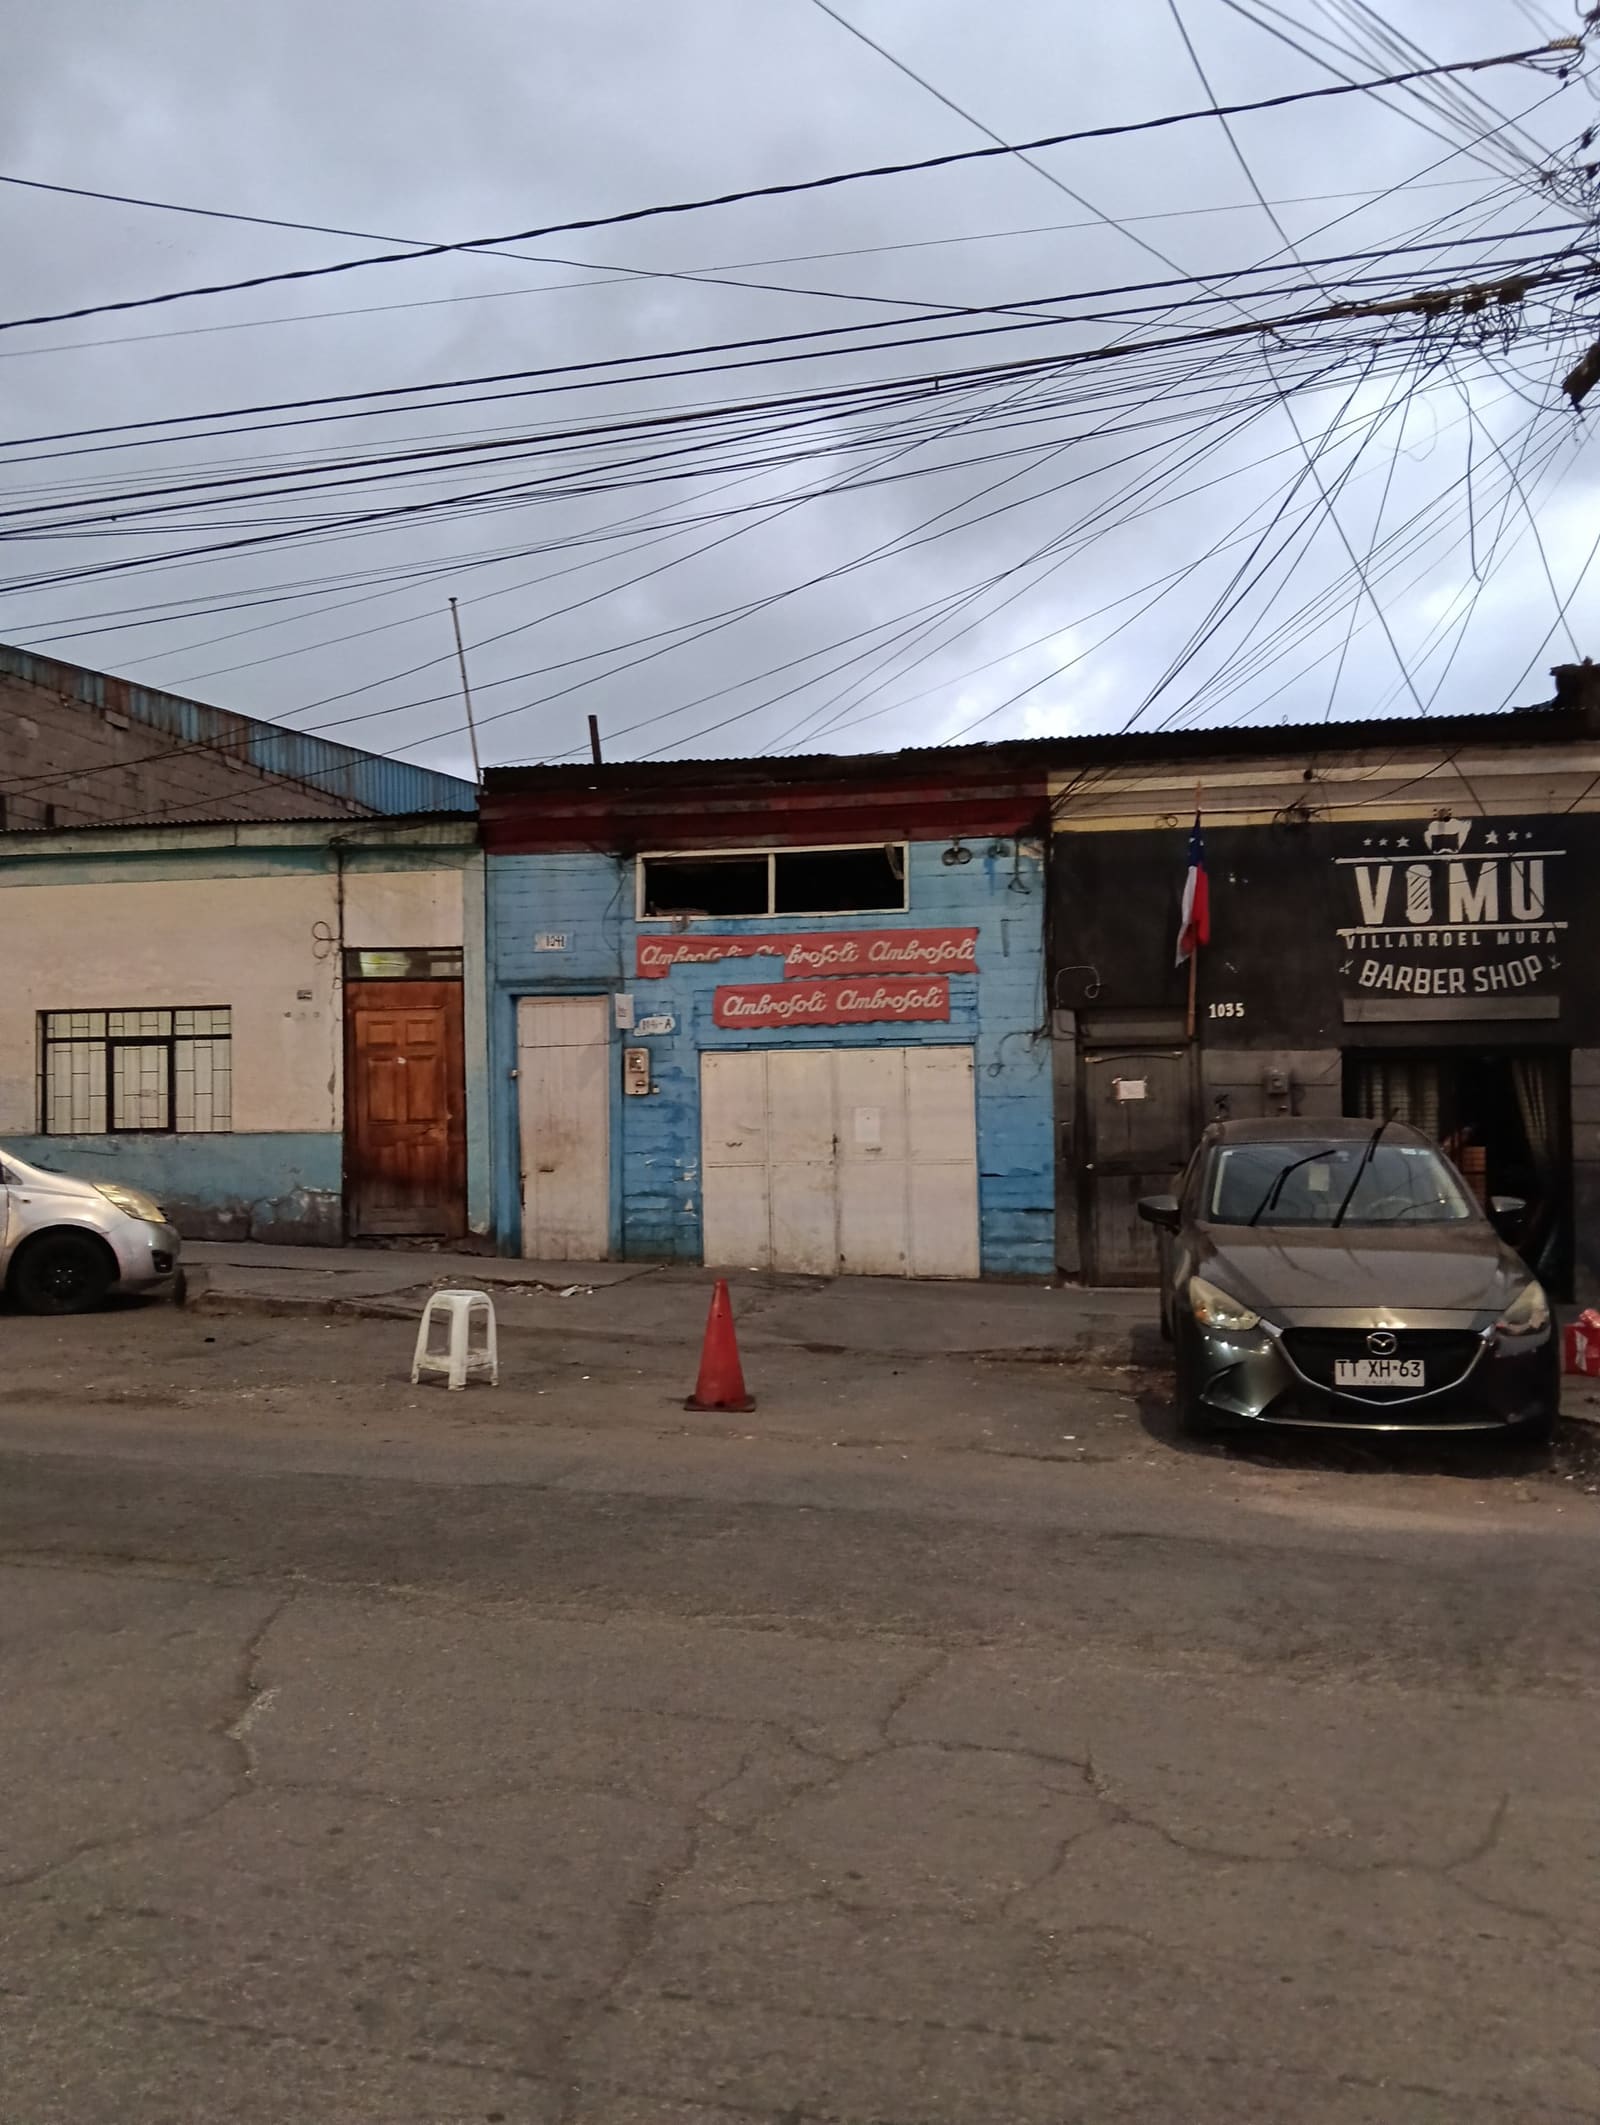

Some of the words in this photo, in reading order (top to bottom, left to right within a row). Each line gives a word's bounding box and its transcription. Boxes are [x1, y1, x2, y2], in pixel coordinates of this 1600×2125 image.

[1345, 931, 1482, 950] VILLARROEL
[1496, 930, 1557, 945] MURA
[1358, 955, 1467, 995] BARBER
[1472, 955, 1543, 993] SHOP
[1208, 1002, 1245, 1018] 1035
